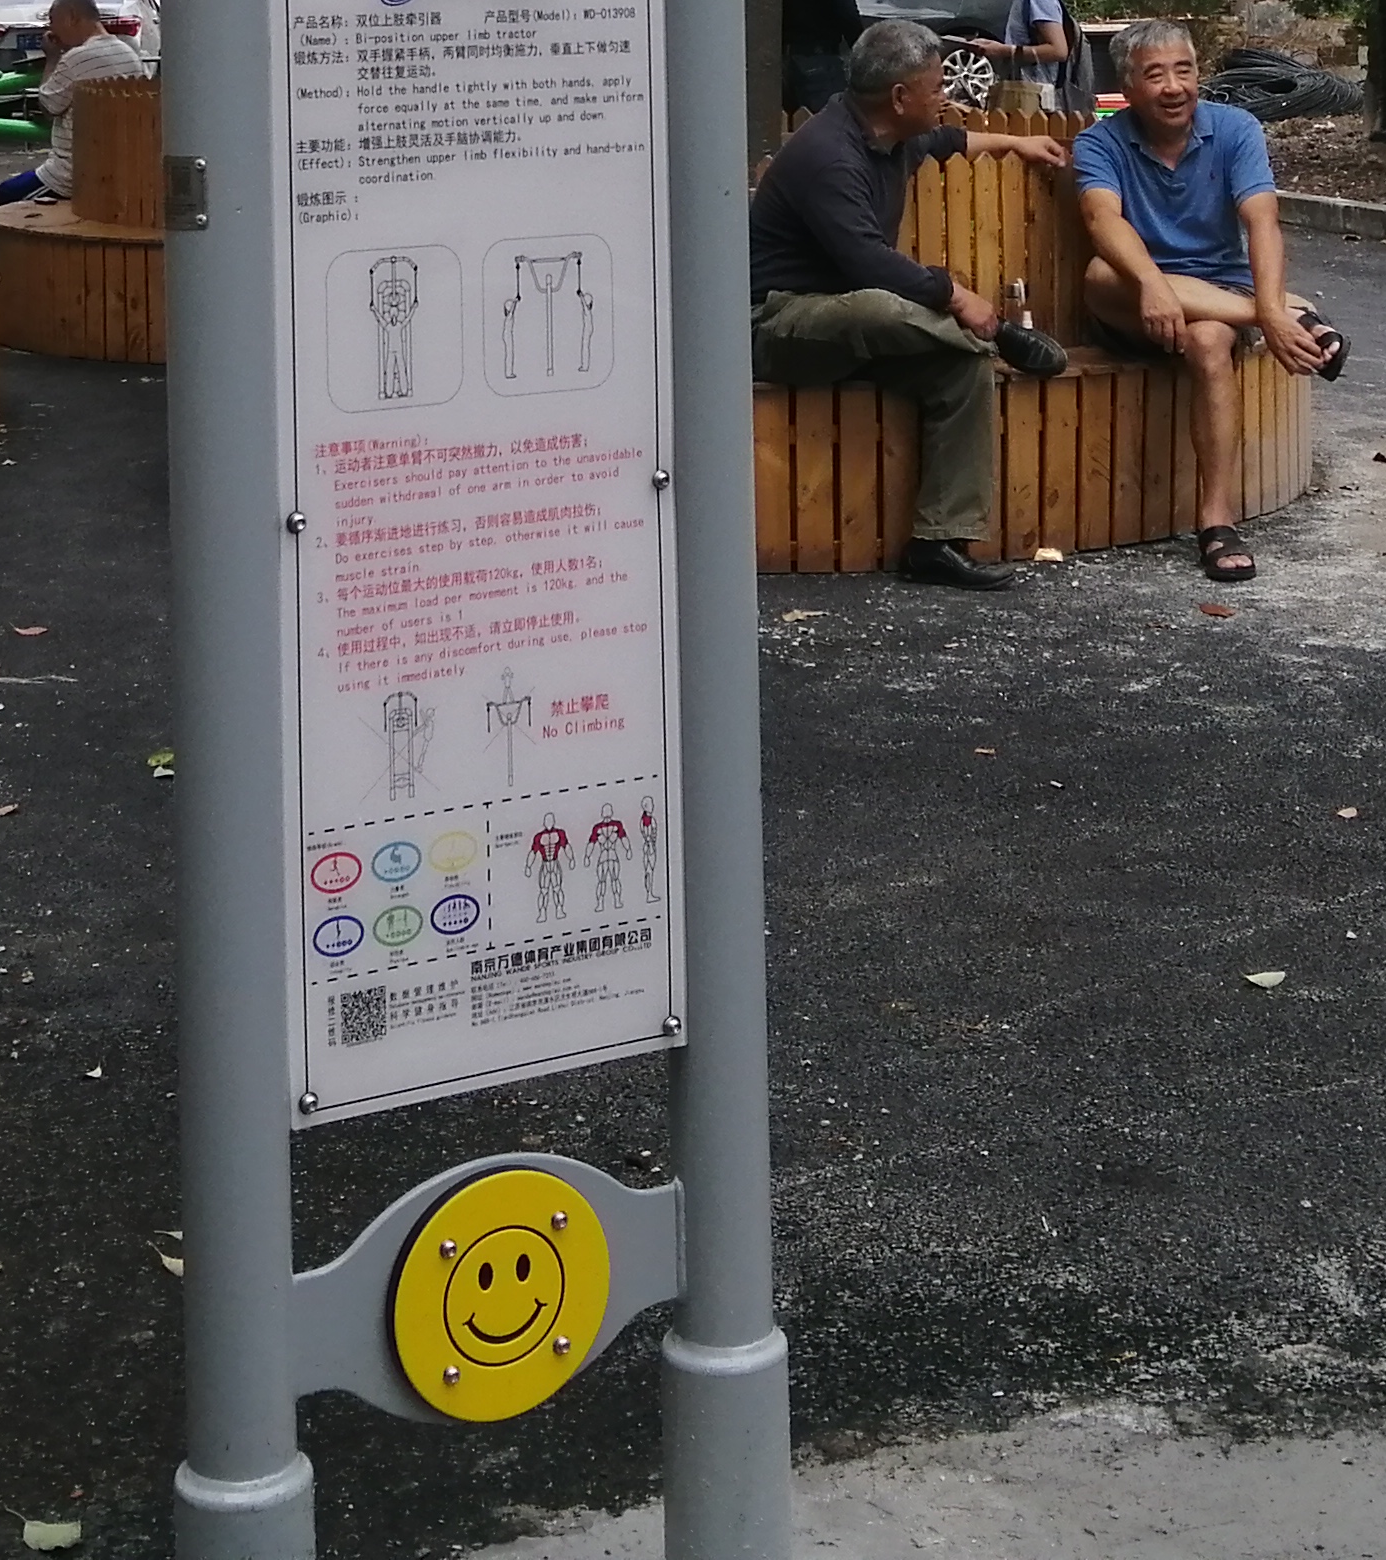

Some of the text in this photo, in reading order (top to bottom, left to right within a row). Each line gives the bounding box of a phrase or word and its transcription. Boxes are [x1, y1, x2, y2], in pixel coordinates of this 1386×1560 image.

[356, 31, 424, 46] Bi-position
[430, 32, 459, 46] upper
[468, 29, 490, 40] limb
[497, 30, 536, 40] tractor
[357, 86, 382, 97] Hold
[389, 85, 406, 95] the
[413, 81, 449, 94] handle
[456, 81, 497, 95] tightly
[503, 80, 527, 90] with
[533, 78, 556, 89] both
[602, 75, 631, 88] apply
[358, 104, 388, 113] force
[395, 100, 437, 112] equally
[444, 100, 454, 110] at
[462, 99, 479, 109] the
[486, 99, 509, 108] same
[551, 94, 568, 105] and
[574, 93, 597, 104] make
[603, 92, 644, 103] uniform
[358, 119, 425, 132] alternating
[431, 116, 468, 129] motion
[474, 111, 534, 125] vertically
[540, 114, 551, 123] up
[557, 111, 575, 122] and
[358, 154, 420, 167] Strengthen
[427, 154, 456, 166] upper
[464, 150, 487, 161] limb
[493, 146, 558, 159] flexibility
[564, 144, 581, 155] and
[586, 142, 645, 155] hand-brain
[334, 447, 643, 491] Exercisers should pay attention to the unavoidable
[335, 467, 619, 509] sudden withdrawal of one arm in order to avoid
[335, 553, 348, 564] Do
[355, 545, 412, 561] exercises
[419, 541, 443, 554] step
[449, 539, 462, 551] by
[505, 526, 560, 543] otherwise
[568, 525, 577, 535] it
[584, 522, 607, 533] will
[614, 518, 644, 530] cause
[335, 568, 374, 582] muscle
[337, 607, 356, 618] The
[362, 601, 408, 615] maximum
[415, 595, 438, 608] load
[444, 594, 462, 605] per
[469, 586, 519, 601] movement
[527, 582, 537, 593] is
[585, 573, 603, 585] and
[611, 571, 628, 582] the
[337, 625, 374, 637] number
[382, 618, 394, 630] of
[401, 614, 432, 628] users
[440, 611, 451, 622] is
[339, 661, 350, 673] If
[357, 657, 389, 670] there
[397, 655, 408, 666] is
[414, 652, 433, 663] any
[439, 640, 502, 659] discomfort
[508, 636, 545, 650] during
[581, 627, 617, 640] please
[623, 622, 648, 633] stop
[337, 664, 465, 692] using it immediately
[551, 694, 609, 717] 禁止攀爬
[543, 717, 625, 738] No Climbing
[471, 927, 652, 975] 南京万德体育产业集团有限公司
